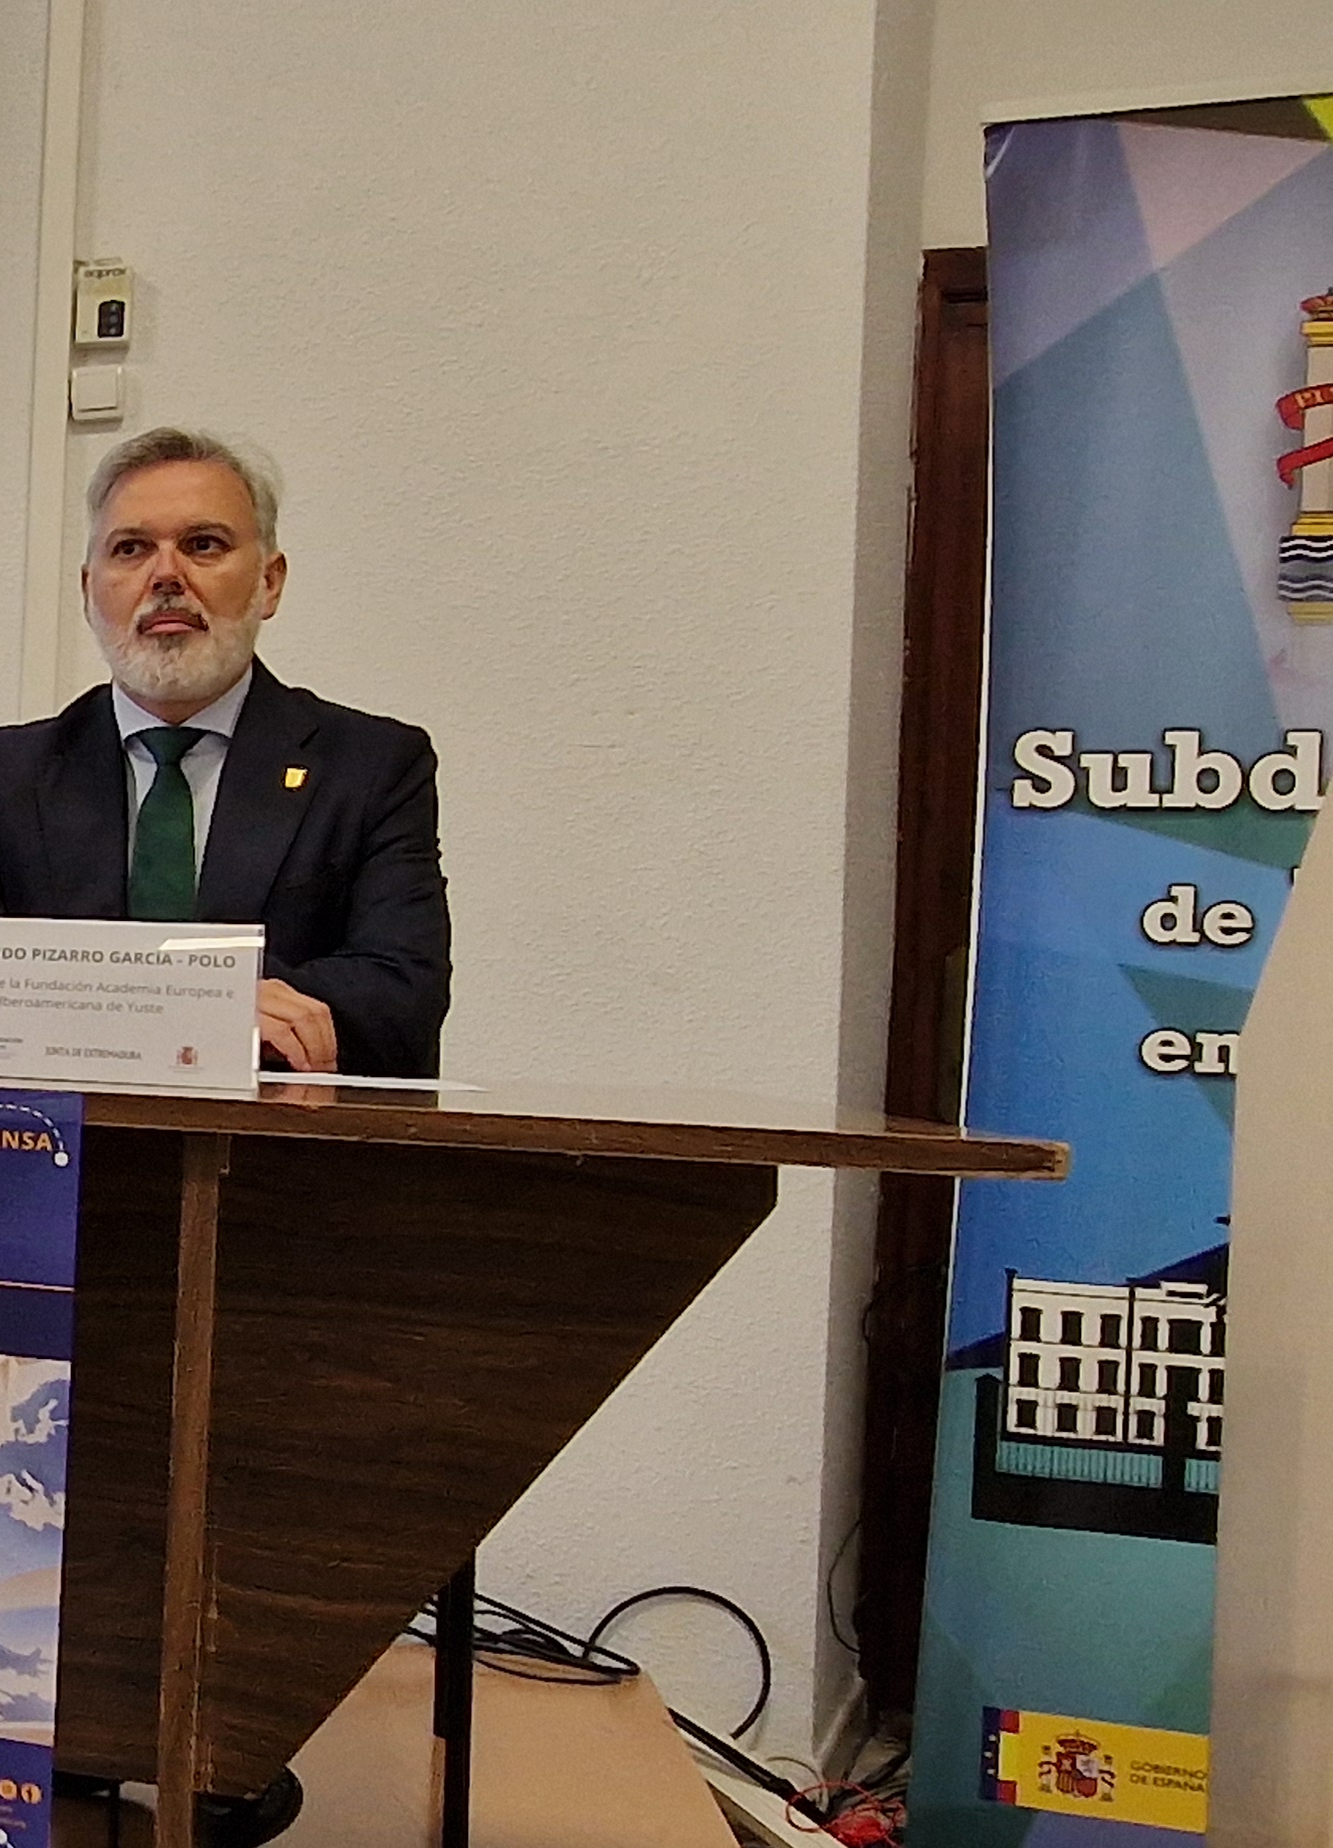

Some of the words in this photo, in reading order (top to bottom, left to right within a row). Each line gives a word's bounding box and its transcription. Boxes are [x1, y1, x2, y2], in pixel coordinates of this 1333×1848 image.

[1141, 883, 1255, 947] de
[32, 947, 104, 963] PIZARRO
[188, 953, 237, 968] POLO
[9, 976, 20, 990] la
[24, 978, 93, 993] Fundación
[96, 982, 161, 996] Academia
[166, 984, 222, 1000] Europea
[106, 1000, 123, 1012] de
[128, 1001, 164, 1015] Yuste
